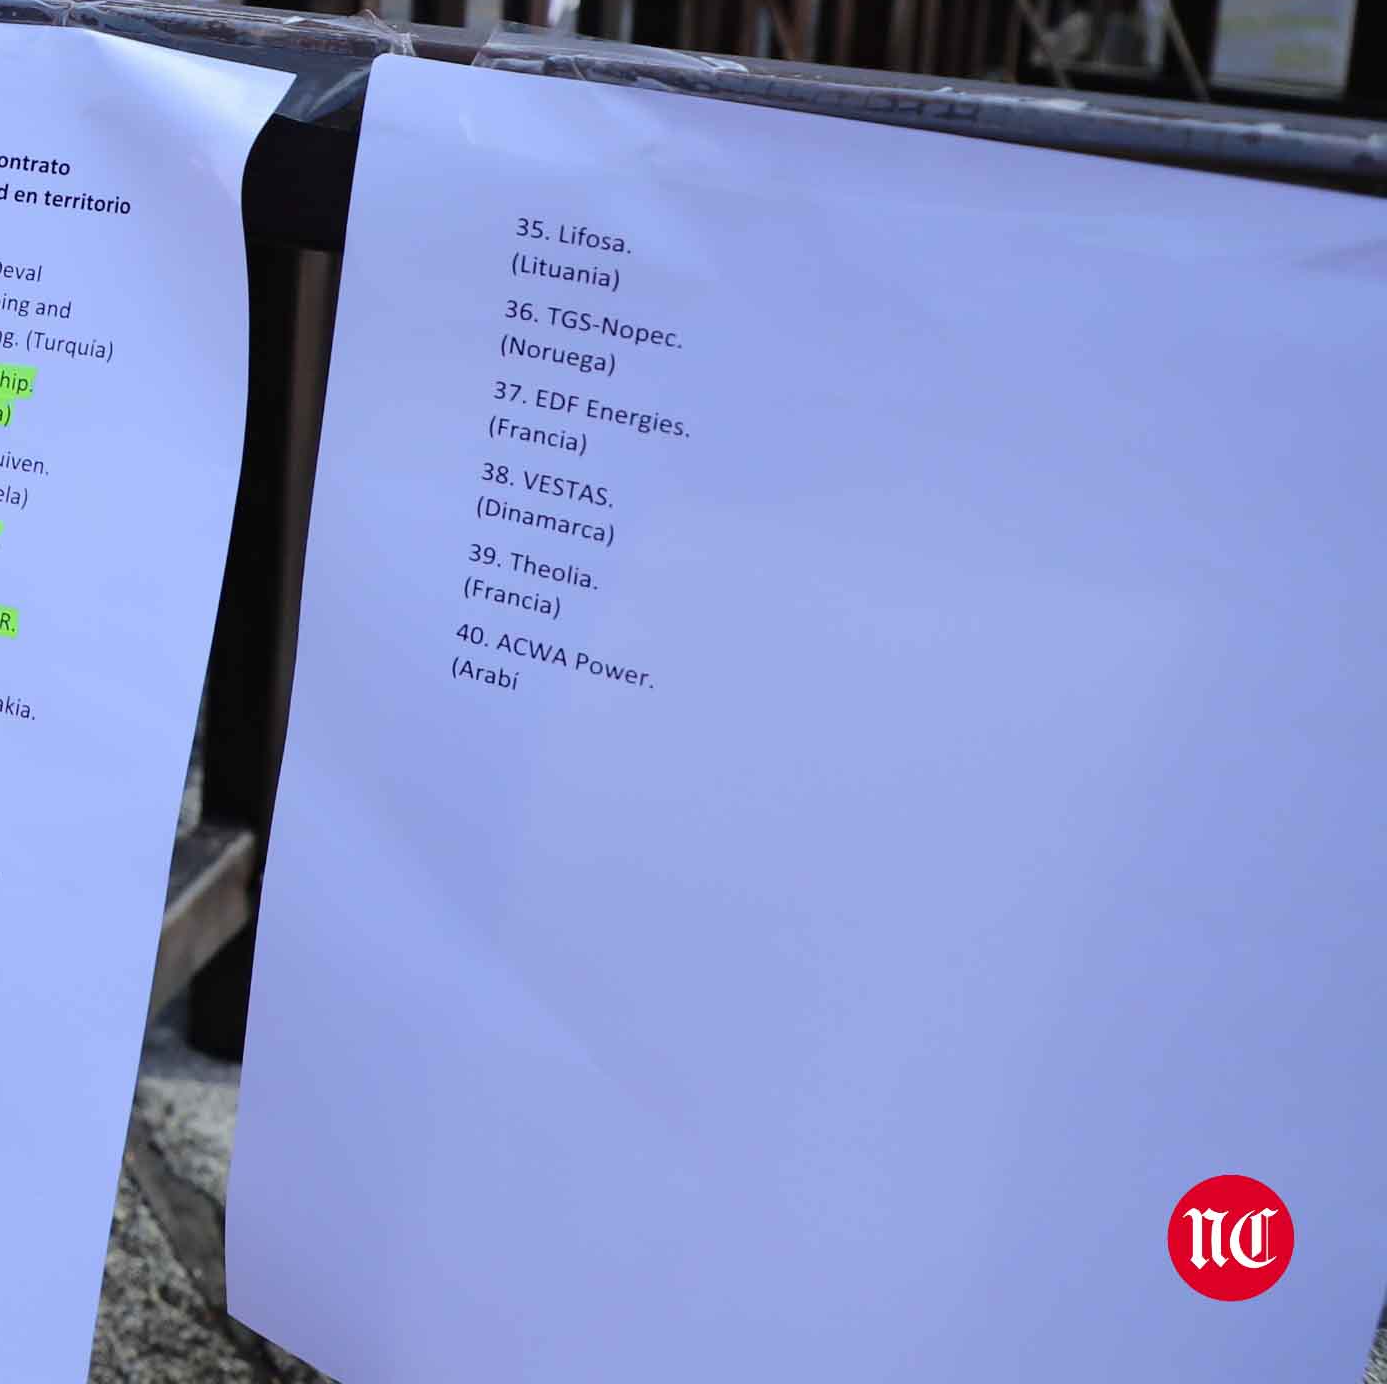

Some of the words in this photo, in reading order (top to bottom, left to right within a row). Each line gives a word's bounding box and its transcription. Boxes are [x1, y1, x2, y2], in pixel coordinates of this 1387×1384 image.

[13, 189, 38, 205] en
[43, 189, 132, 215] territorio
[515, 217, 550, 241] 35.
[558, 224, 632, 255] Lifosa.
[511, 251, 620, 293] (Lituania)
[34, 300, 72, 320] and
[504, 299, 539, 323] 36.
[546, 306, 682, 349] TGS-Nopec.
[500, 333, 616, 377] (Noruega)
[493, 380, 527, 405] 37.
[535, 388, 580, 414] EDF
[586, 399, 690, 438] Energies.
[488, 415, 587, 457] (Francia)
[481, 462, 515, 487] 38.
[523, 470, 613, 509] VESTAS.
[476, 495, 615, 548] (Dinamarca)
[468, 543, 502, 568] 39.
[510, 551, 598, 591] Theolia.
[463, 576, 561, 621] (Francia)
[455, 623, 489, 648] 40.
[495, 633, 568, 668] ACWA
[575, 651, 654, 689] Power.
